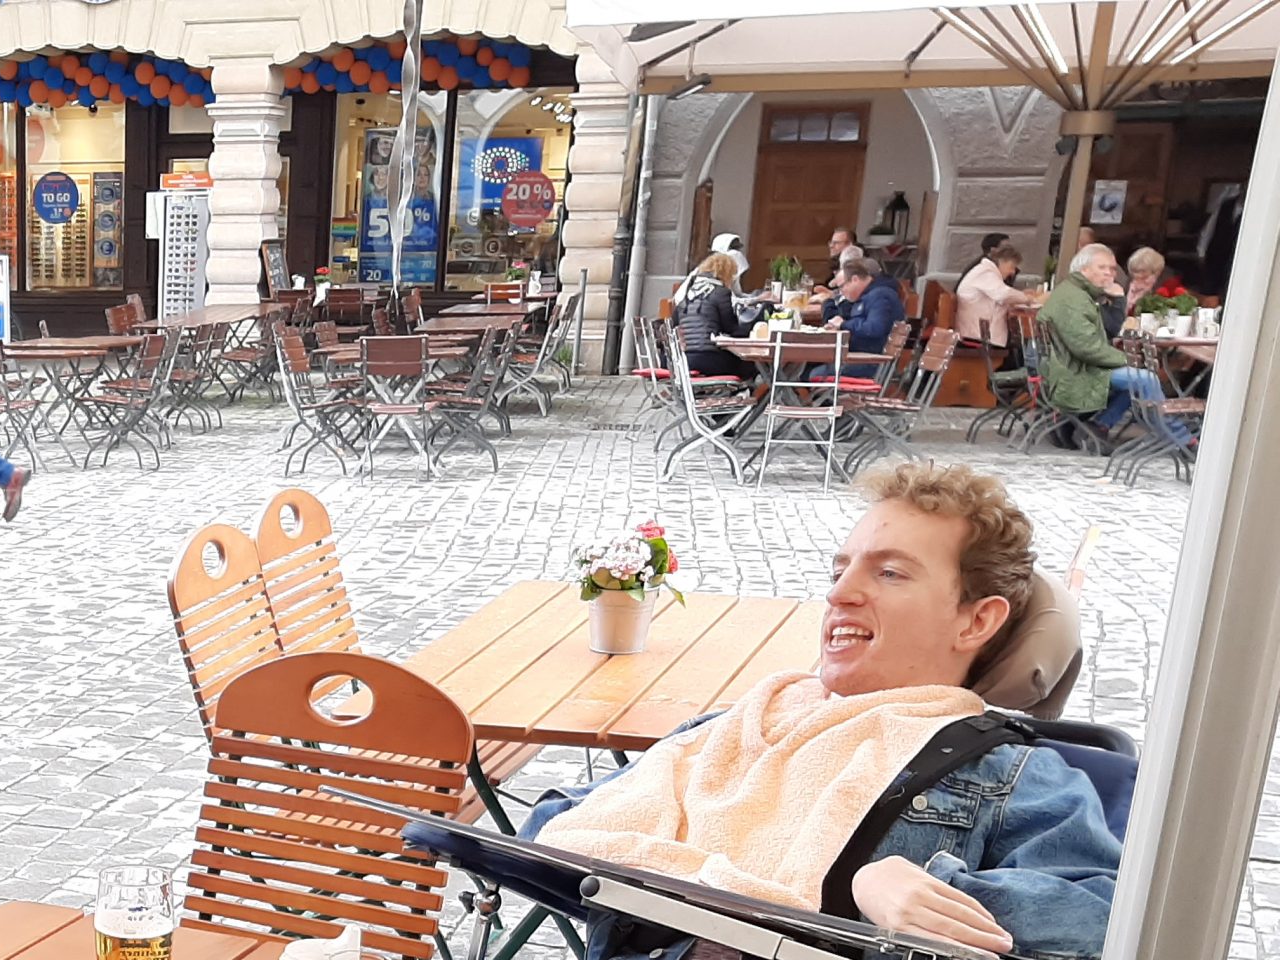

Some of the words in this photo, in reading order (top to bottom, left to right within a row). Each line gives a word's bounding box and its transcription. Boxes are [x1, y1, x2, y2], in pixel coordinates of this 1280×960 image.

[42, 193, 54, 202] TO
[56, 193, 70, 202] GO
[507, 184, 531, 200] 20
[533, 183, 551, 200] %
